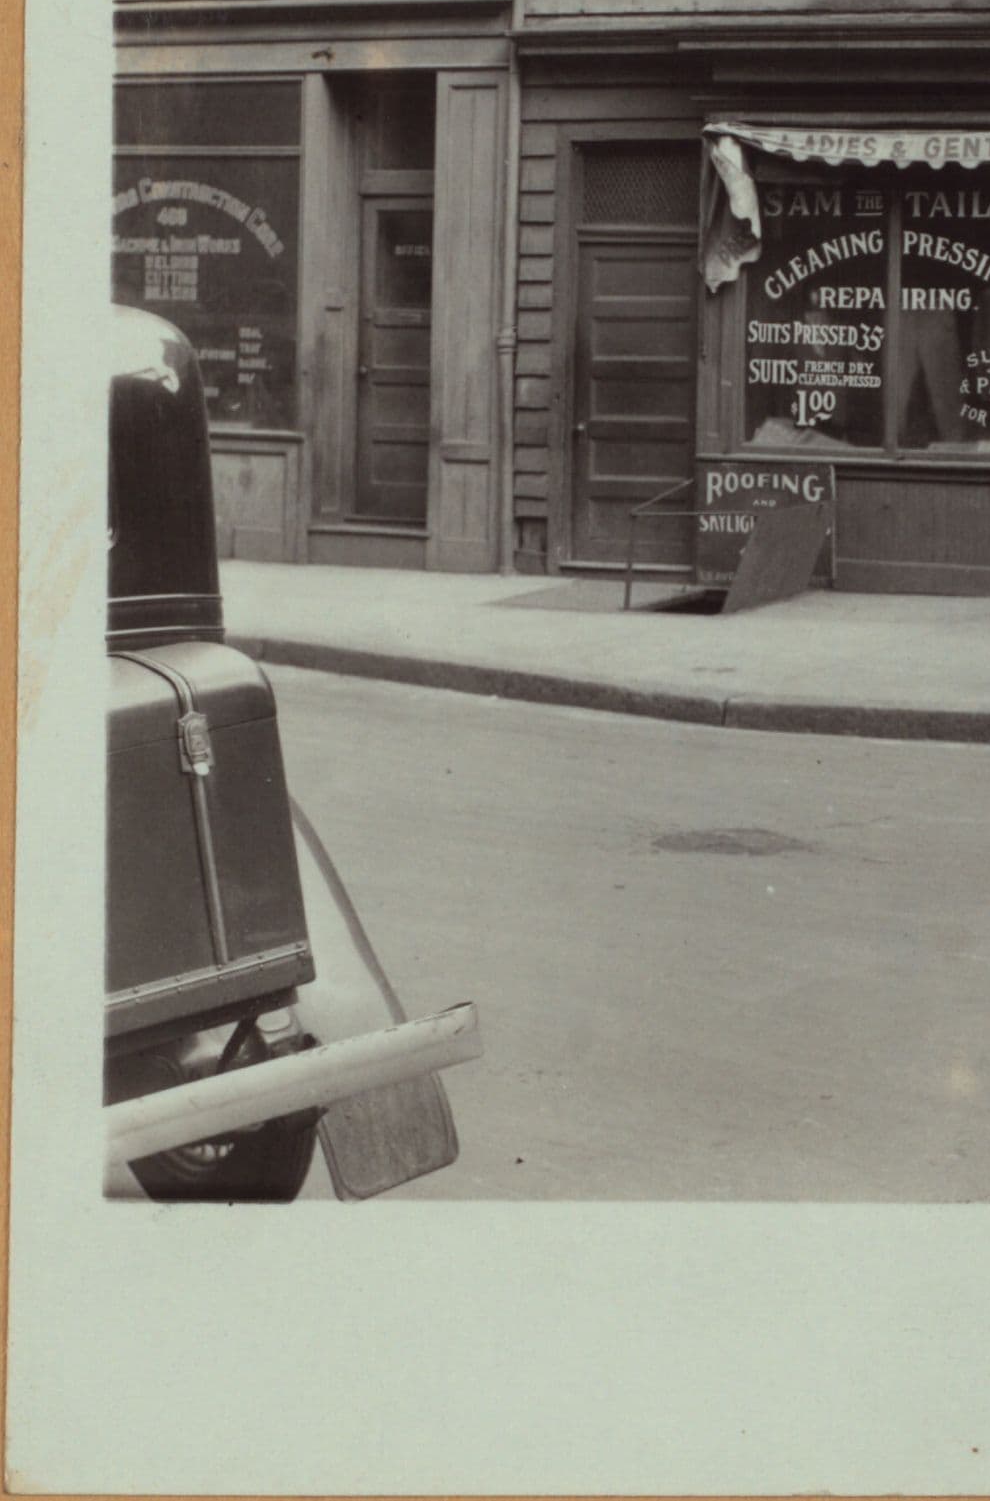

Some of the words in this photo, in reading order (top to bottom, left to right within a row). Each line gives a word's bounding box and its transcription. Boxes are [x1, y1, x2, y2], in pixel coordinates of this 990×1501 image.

[891, 140, 905, 159] &
[765, 191, 842, 217] SAM
[856, 195, 885, 210] THE
[765, 230, 883, 299] CLEANING
[748, 320, 791, 344] SUITS
[793, 321, 858, 346] PRESSED
[749, 359, 798, 385] SUITS
[804, 361, 844, 374] FRENCH
[848, 362, 874, 375] DRY
[960, 379, 970, 394] &
[960, 403, 987, 428] FOR
[706, 472, 825, 506] ROOFING
[752, 499, 777, 507] AND
